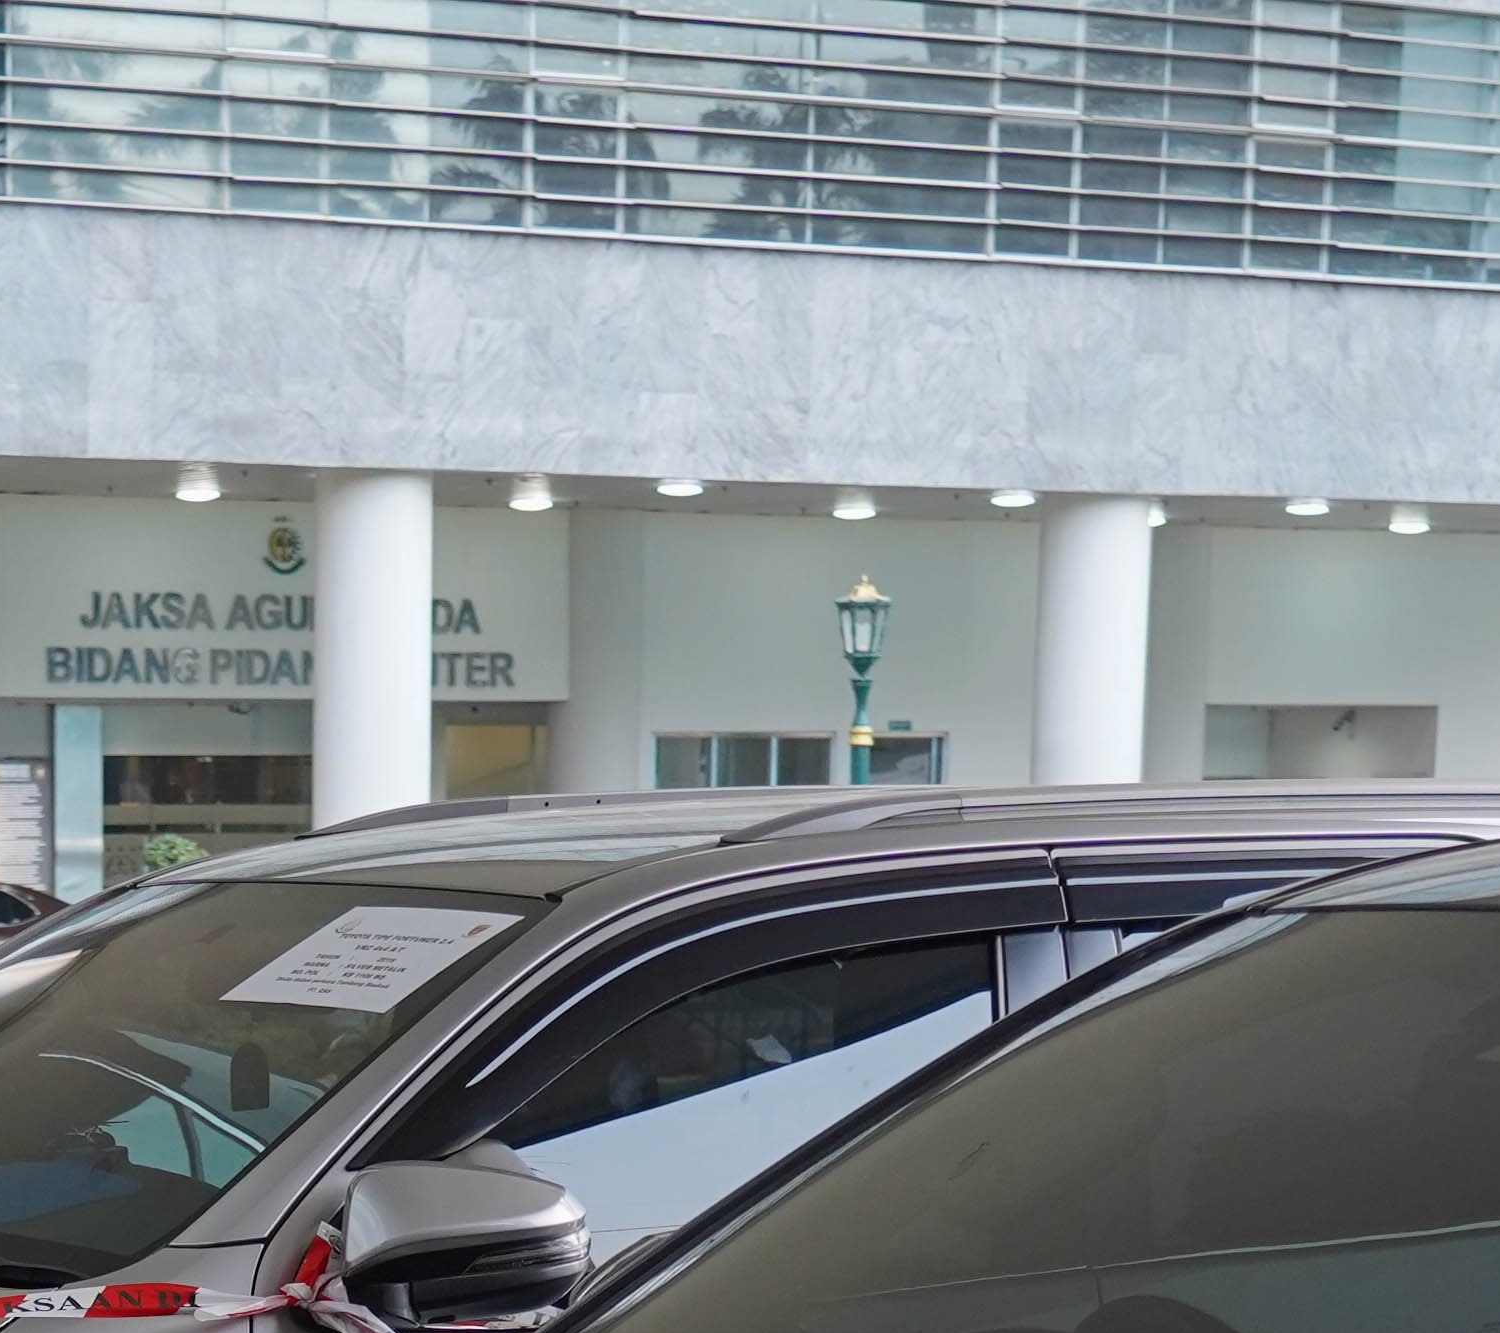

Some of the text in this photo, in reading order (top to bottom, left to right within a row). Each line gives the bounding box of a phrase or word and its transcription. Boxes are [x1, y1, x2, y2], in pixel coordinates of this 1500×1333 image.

[80, 591, 481, 634] JAKSA AGU DA
[45, 645, 201, 685] BIDANG
